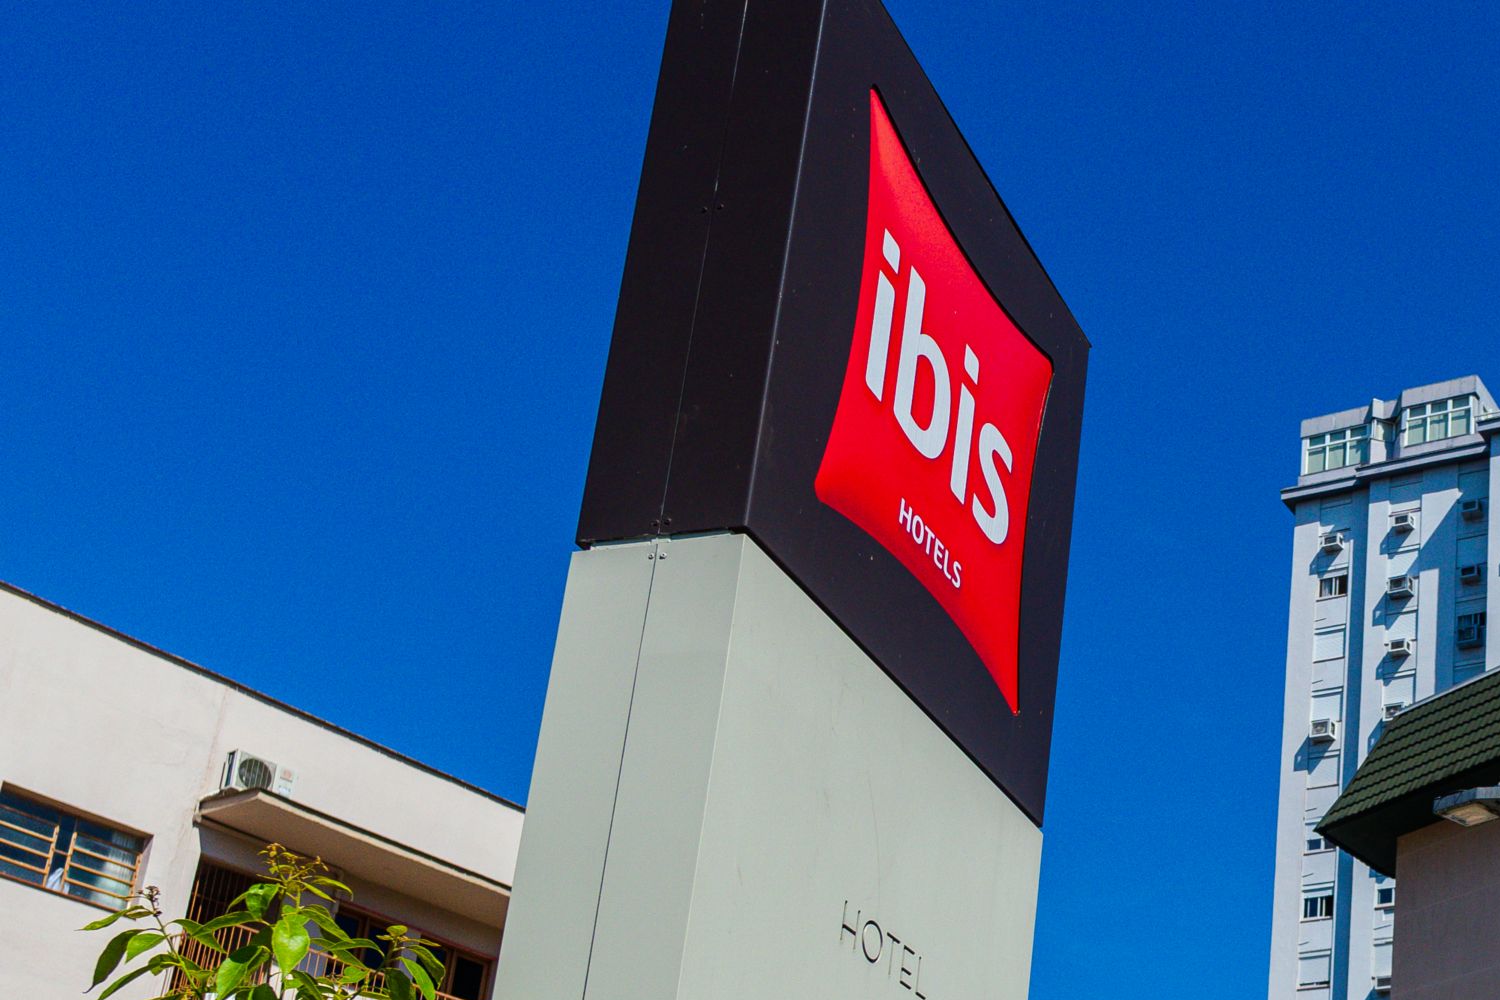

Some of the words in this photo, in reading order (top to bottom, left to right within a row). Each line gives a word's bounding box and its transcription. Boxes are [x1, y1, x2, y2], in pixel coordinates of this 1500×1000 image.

[865, 228, 1014, 546] ibis
[899, 497, 962, 590] HOTELS
[838, 899, 927, 1000] HOTEL
